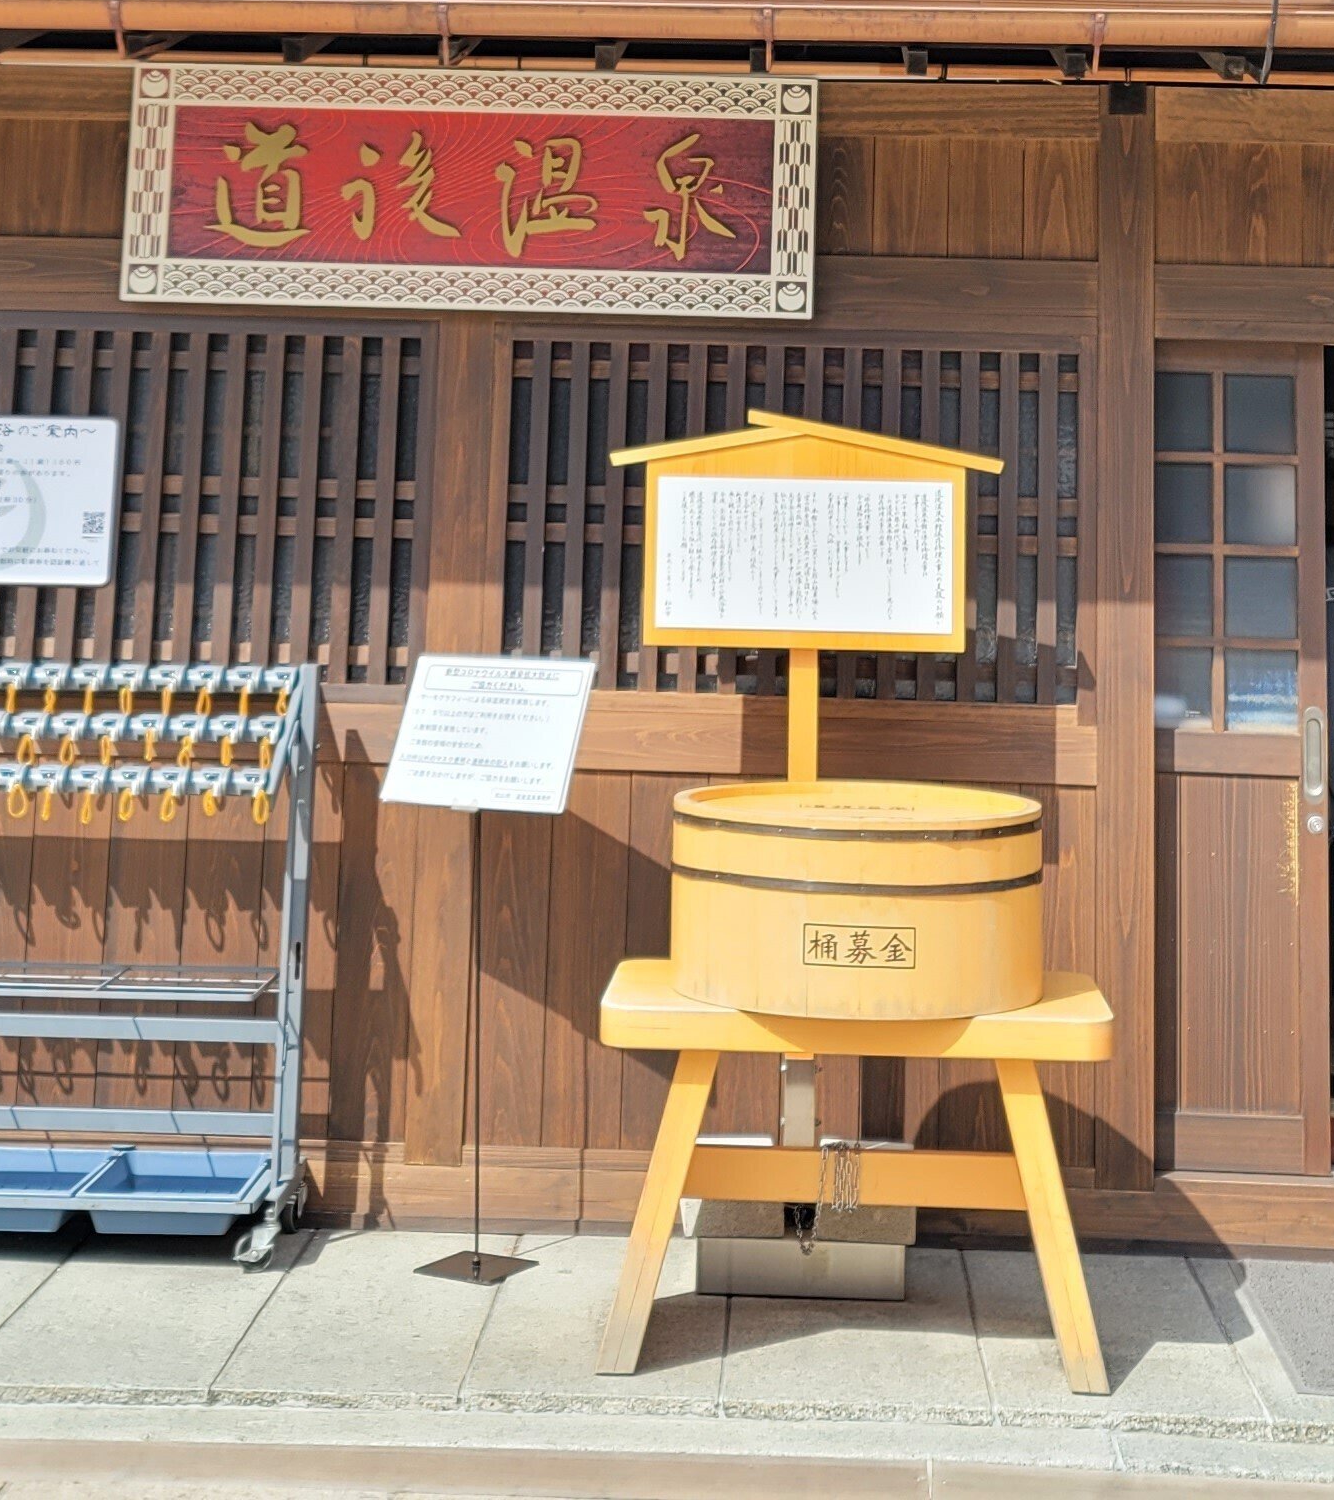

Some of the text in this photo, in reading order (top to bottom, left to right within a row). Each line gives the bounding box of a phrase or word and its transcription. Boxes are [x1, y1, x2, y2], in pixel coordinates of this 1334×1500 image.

[202, 121, 737, 260] 道後温泉
[807, 929, 913, 964] 桶募金
